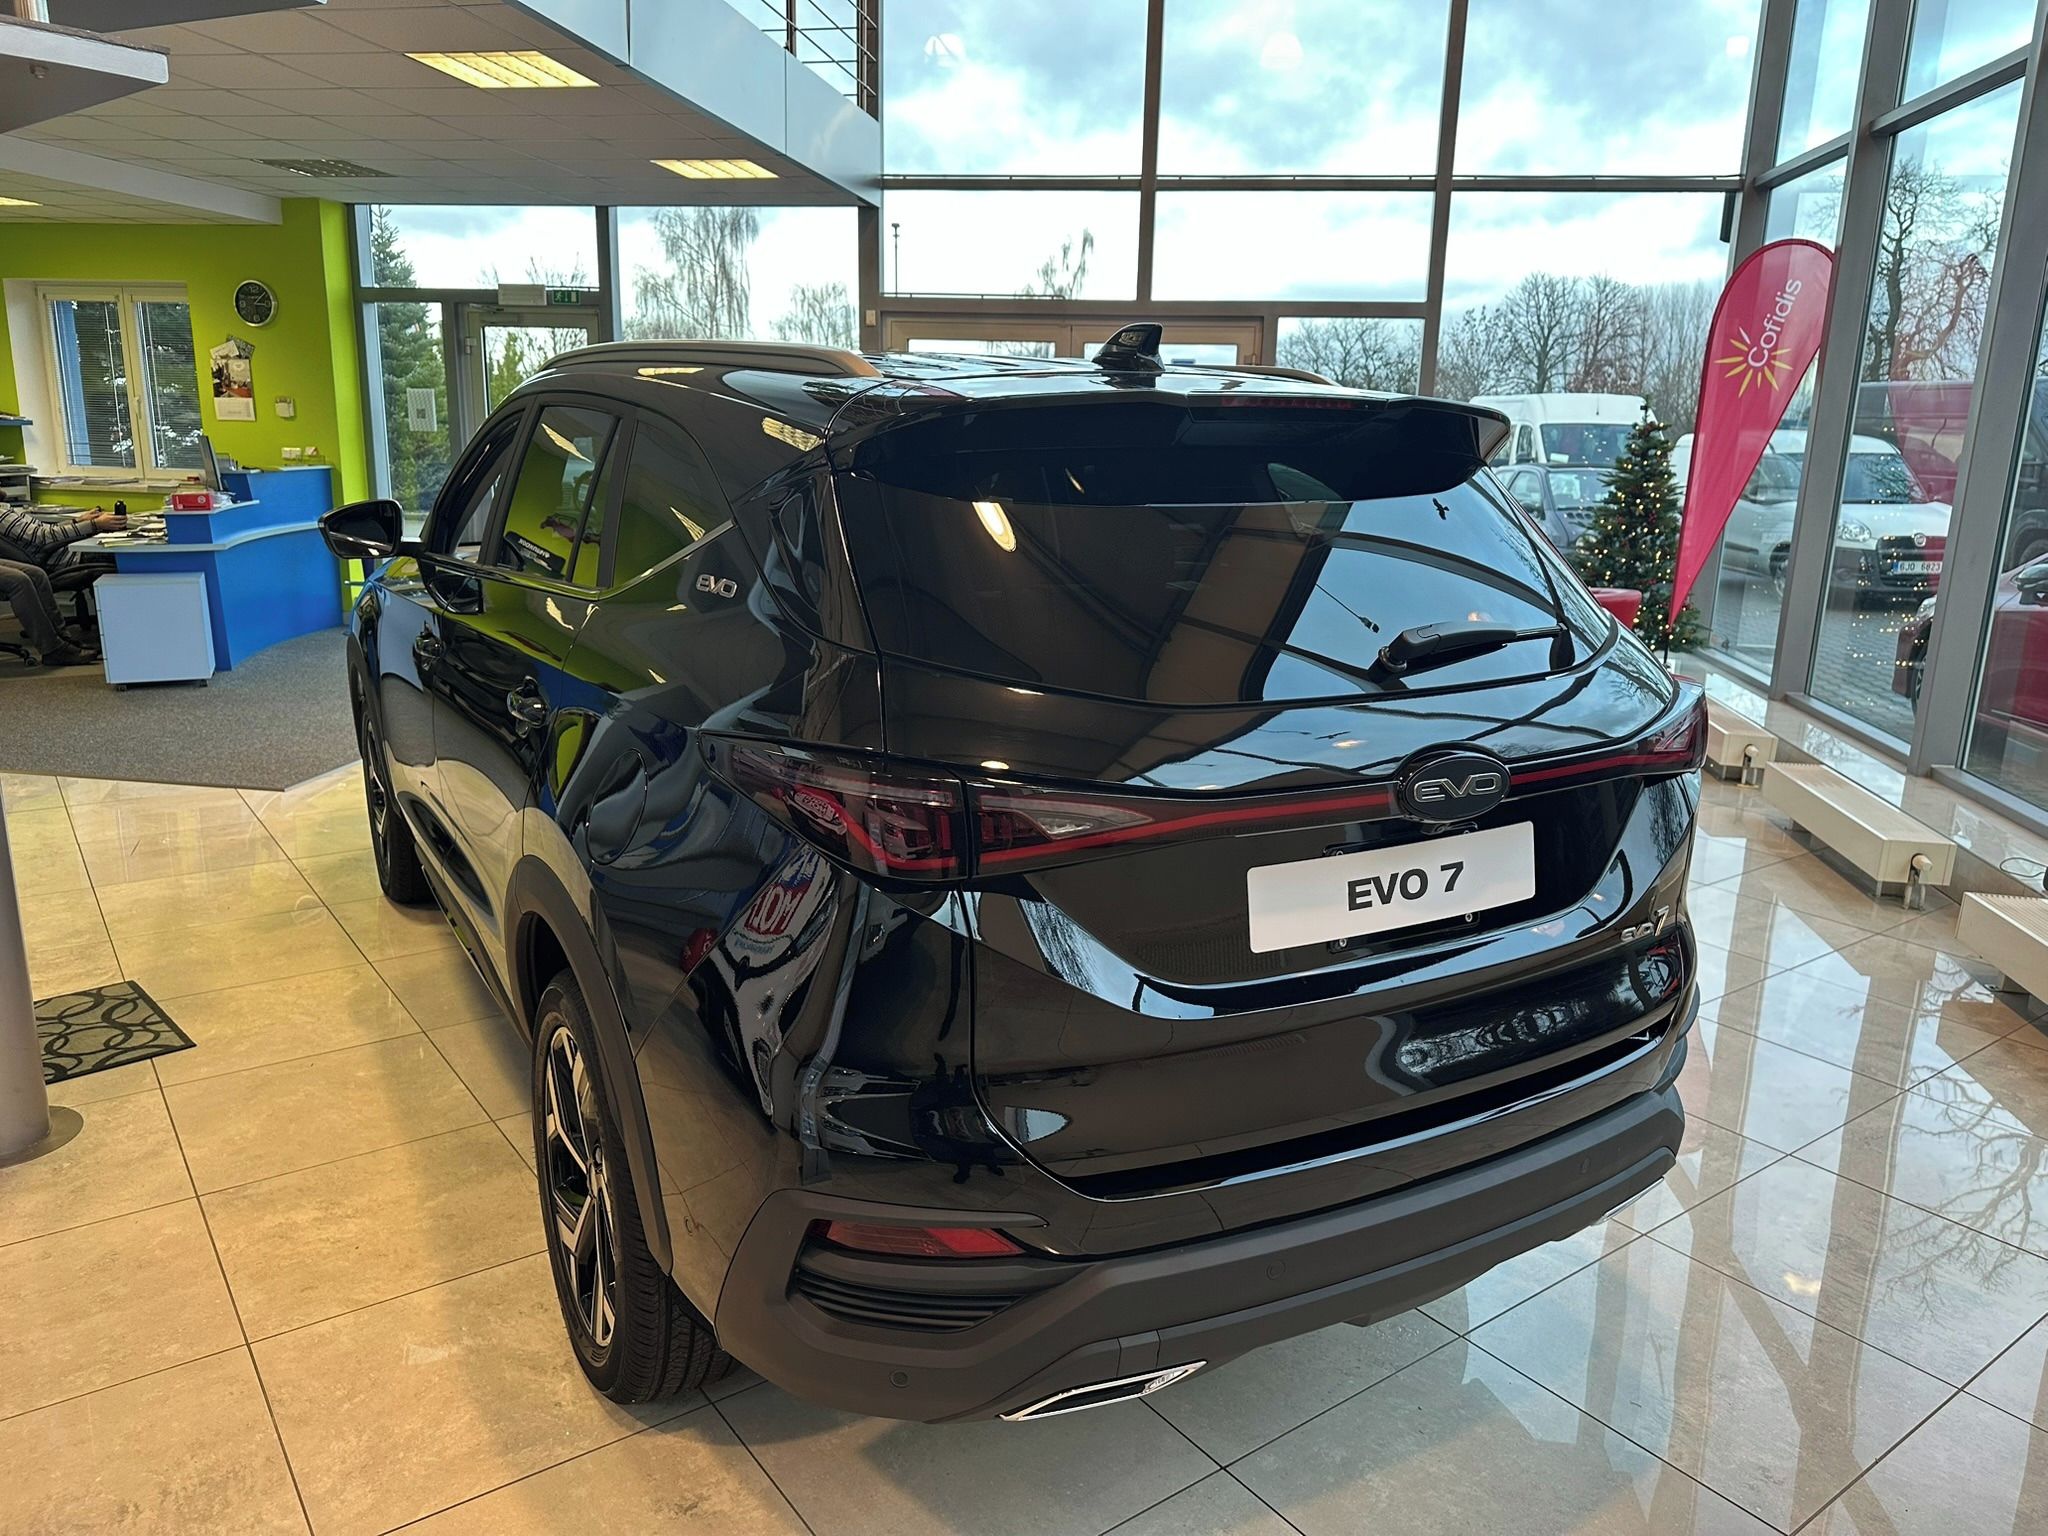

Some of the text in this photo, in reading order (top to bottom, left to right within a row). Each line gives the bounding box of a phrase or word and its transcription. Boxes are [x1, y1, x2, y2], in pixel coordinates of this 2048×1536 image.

[1747, 279, 1802, 368] Cofidis
[696, 573, 738, 599] EVO
[1413, 772, 1502, 803] EVO
[1347, 861, 1464, 911] EVO 7
[1655, 905, 1670, 937] 7
